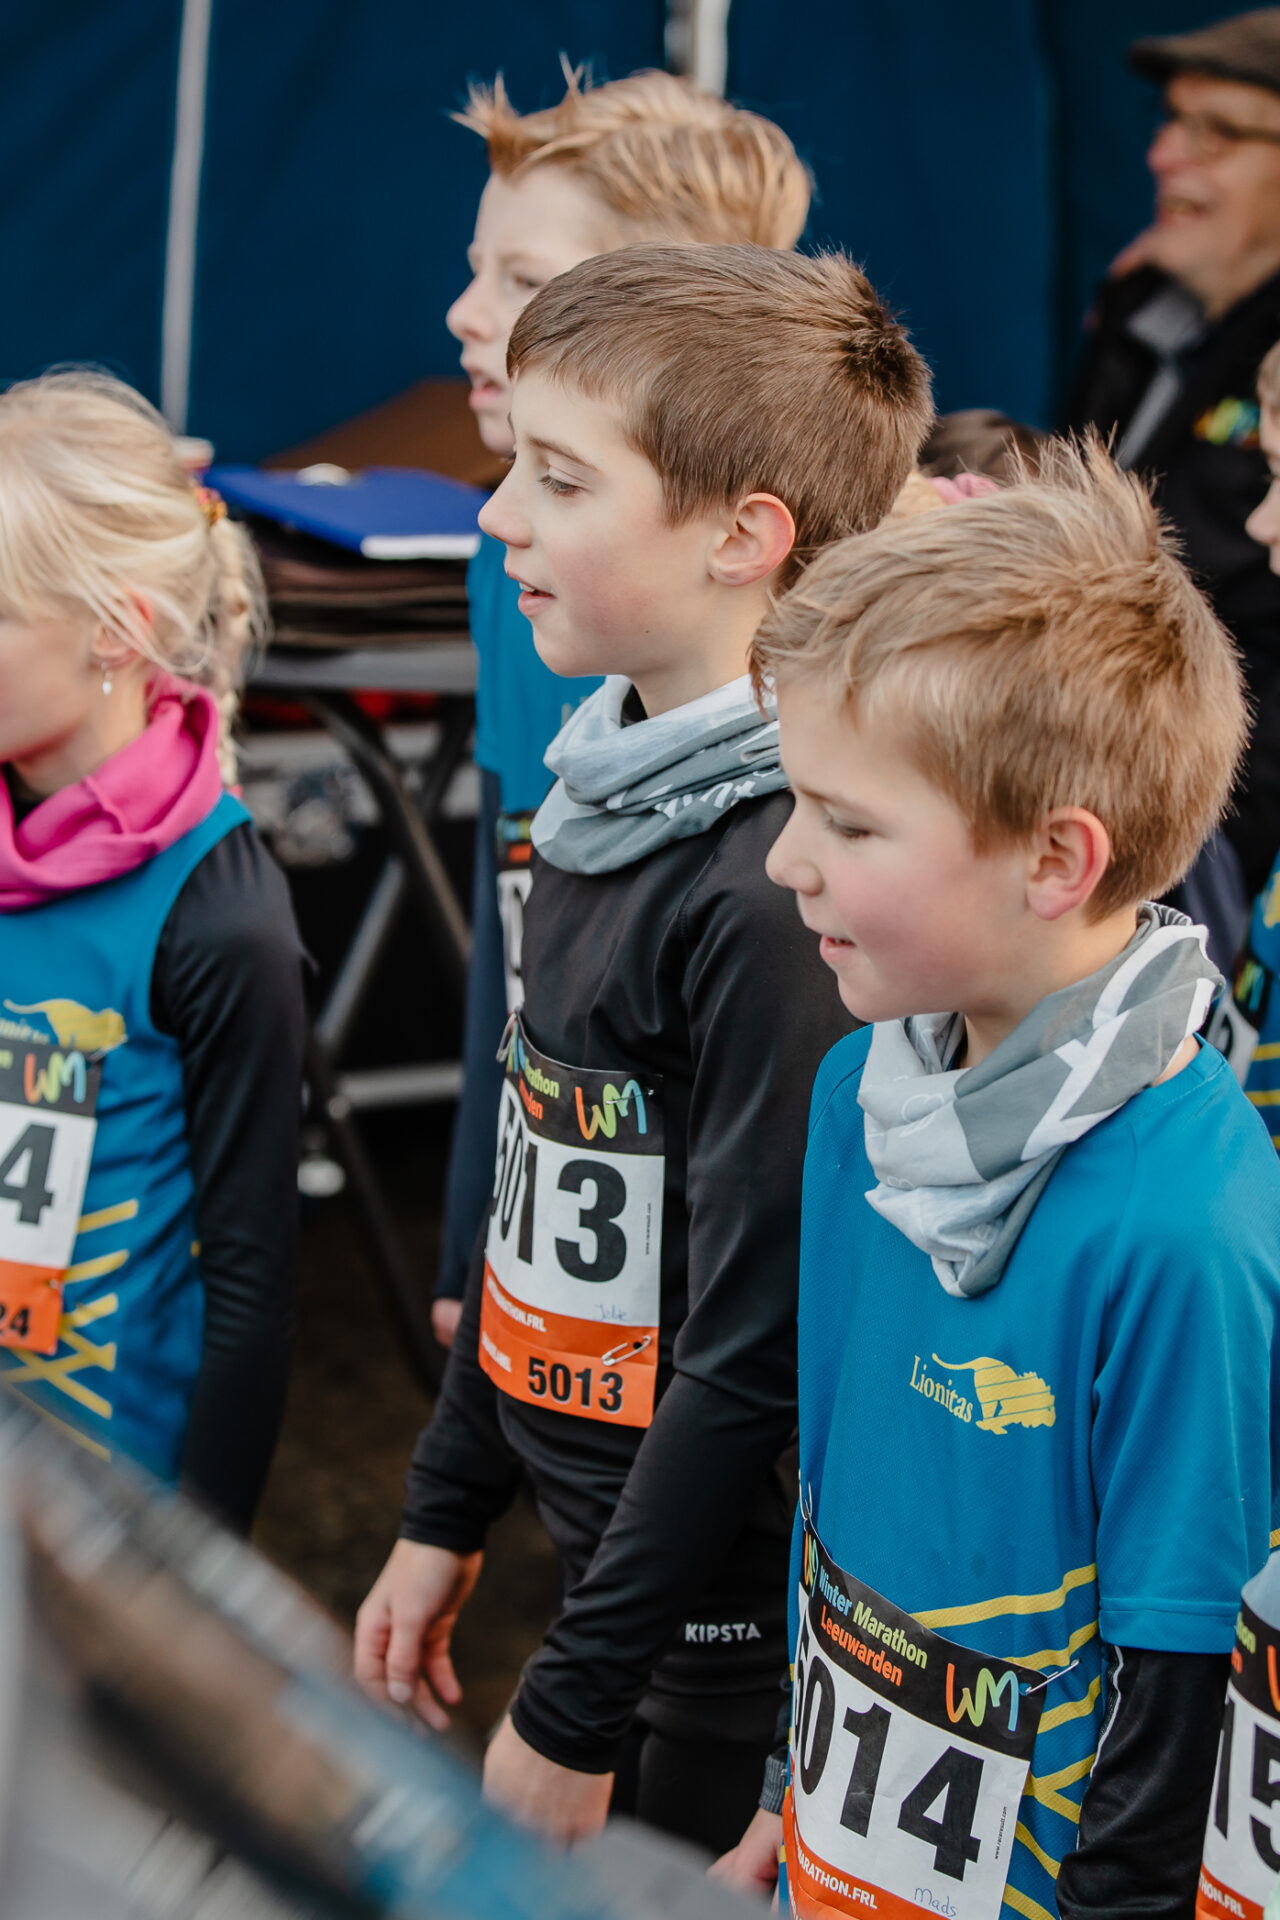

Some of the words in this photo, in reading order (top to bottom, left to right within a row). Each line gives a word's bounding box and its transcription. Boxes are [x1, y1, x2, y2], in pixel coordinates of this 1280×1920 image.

[574, 1079, 648, 1141] WM
[0, 1123, 53, 1226] 4
[527, 1355, 624, 1415] 5013
[909, 1354, 974, 1424] Lionitas
[684, 1622, 762, 1643] KIPSTA
[818, 1564, 853, 1617] Winter
[852, 1600, 929, 1670] Marathon
[820, 1604, 904, 1687] Leeuwarden
[945, 1662, 1020, 1732] WM
[914, 1887, 956, 1918] Mads
